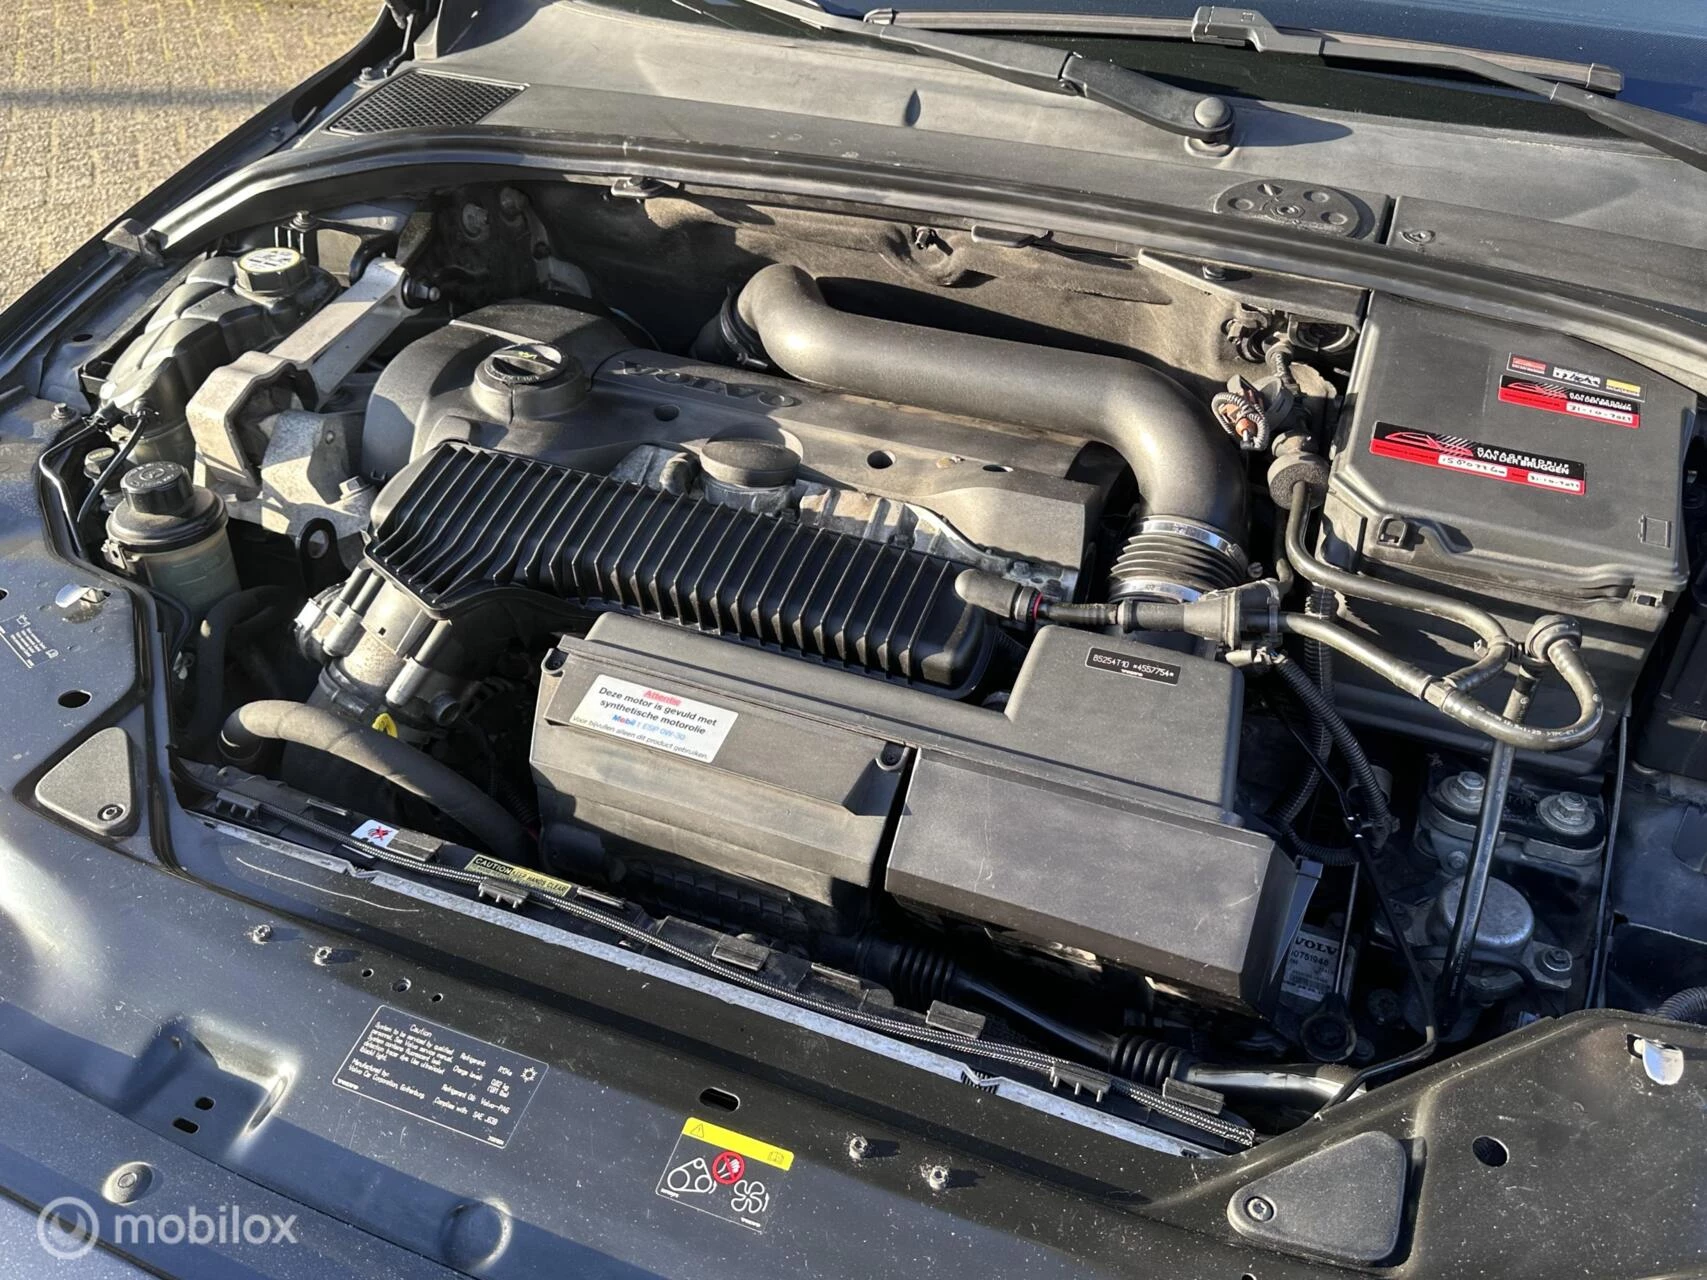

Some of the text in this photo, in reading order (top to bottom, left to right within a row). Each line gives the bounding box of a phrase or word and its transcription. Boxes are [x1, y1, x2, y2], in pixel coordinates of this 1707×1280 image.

[1477, 451, 1570, 475] VAN DER BRUGGEN
[599, 687, 717, 727] Deze motor is gevuld met
[599, 700, 706, 735] synthetische motorolie
[612, 714, 636, 727] Mobil
[572, 716, 588, 725] Voor
[615, 726, 636, 740] alleen
[636, 731, 646, 741] dit
[646, 734, 673, 750] product
[475, 858, 512, 874] CAUTION
[1295, 937, 1339, 955] VOLV
[410, 1024, 432, 1036] Caution
